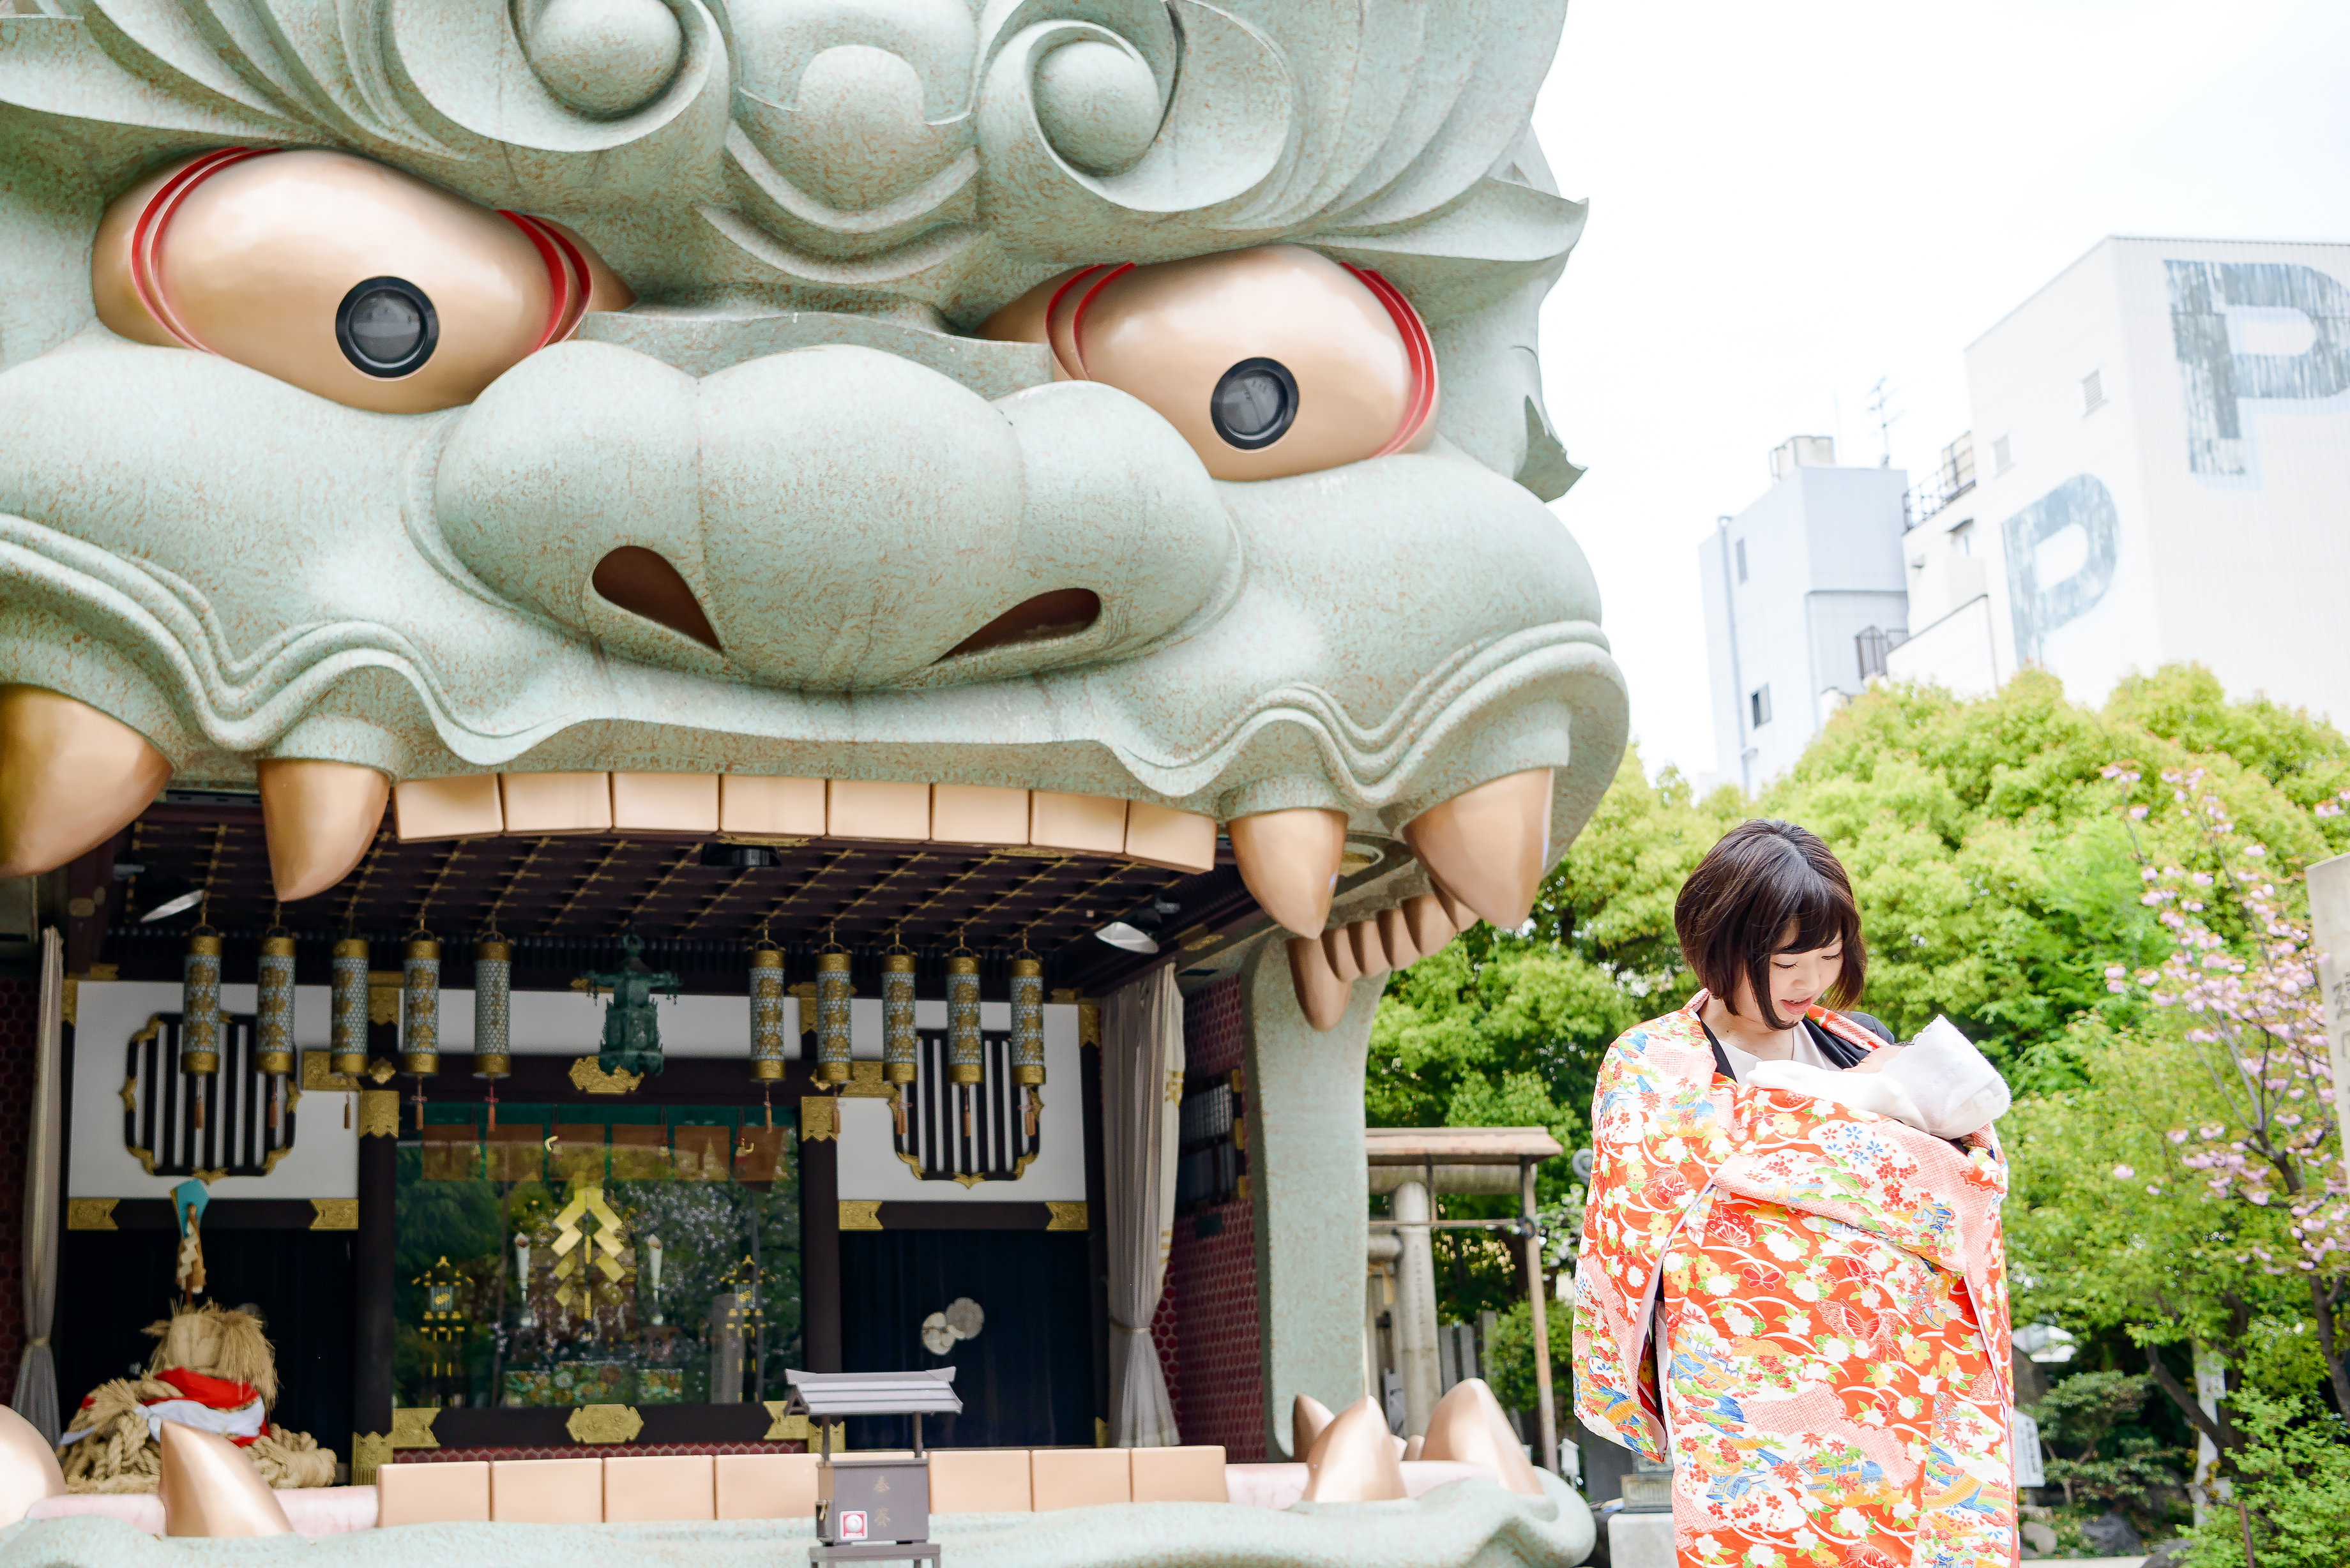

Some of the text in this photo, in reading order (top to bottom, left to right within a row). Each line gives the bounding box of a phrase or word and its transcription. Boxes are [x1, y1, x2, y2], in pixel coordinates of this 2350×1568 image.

[2163, 259, 2350, 476] P
[2001, 473, 2119, 670] P
[407, 967, 437, 1049] 御神燈
[756, 977, 784, 1055] 御神燈
[822, 979, 850, 1057] 御神燈
[888, 981, 915, 1058] 御神燈
